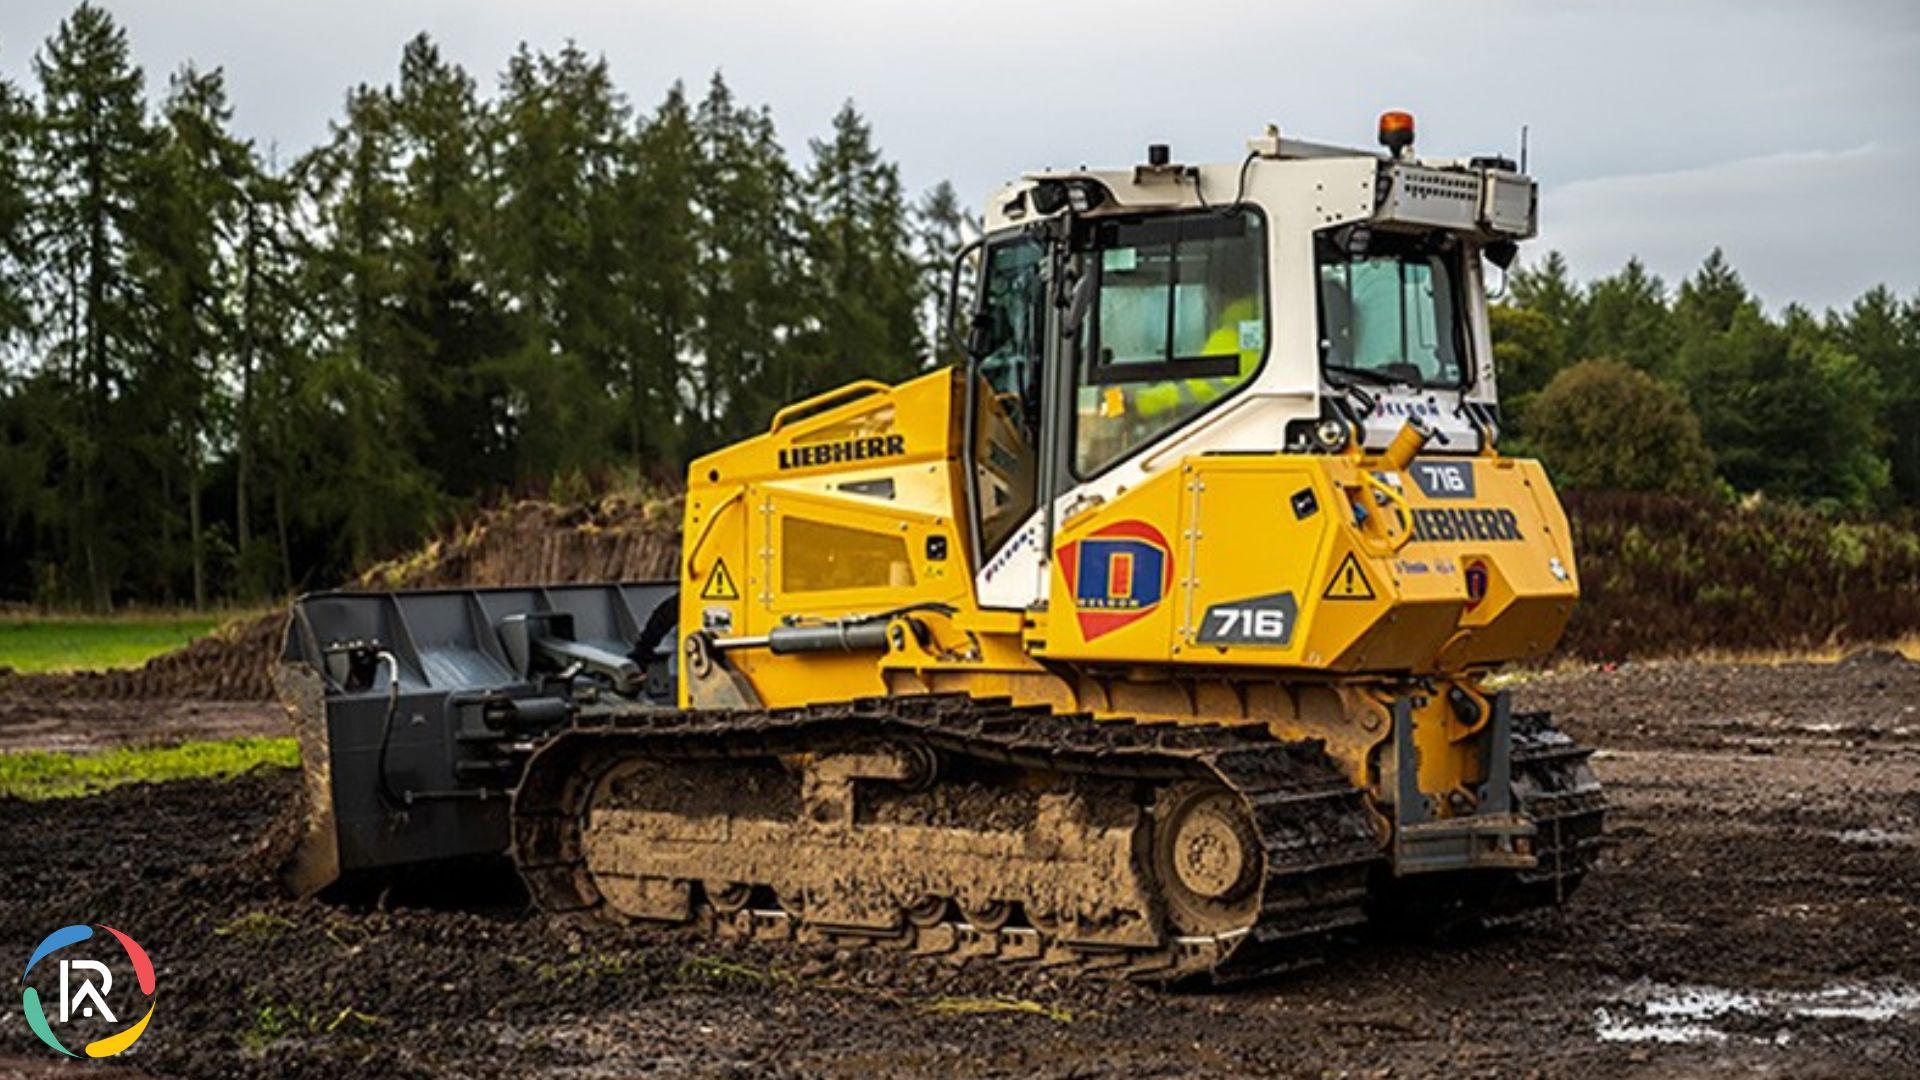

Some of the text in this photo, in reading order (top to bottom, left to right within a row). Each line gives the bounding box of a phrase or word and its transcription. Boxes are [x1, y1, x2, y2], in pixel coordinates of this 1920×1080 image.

[777, 434, 905, 470] LIEBHERR
[1421, 466, 1466, 492] 716
[1211, 609, 1284, 638] 716
